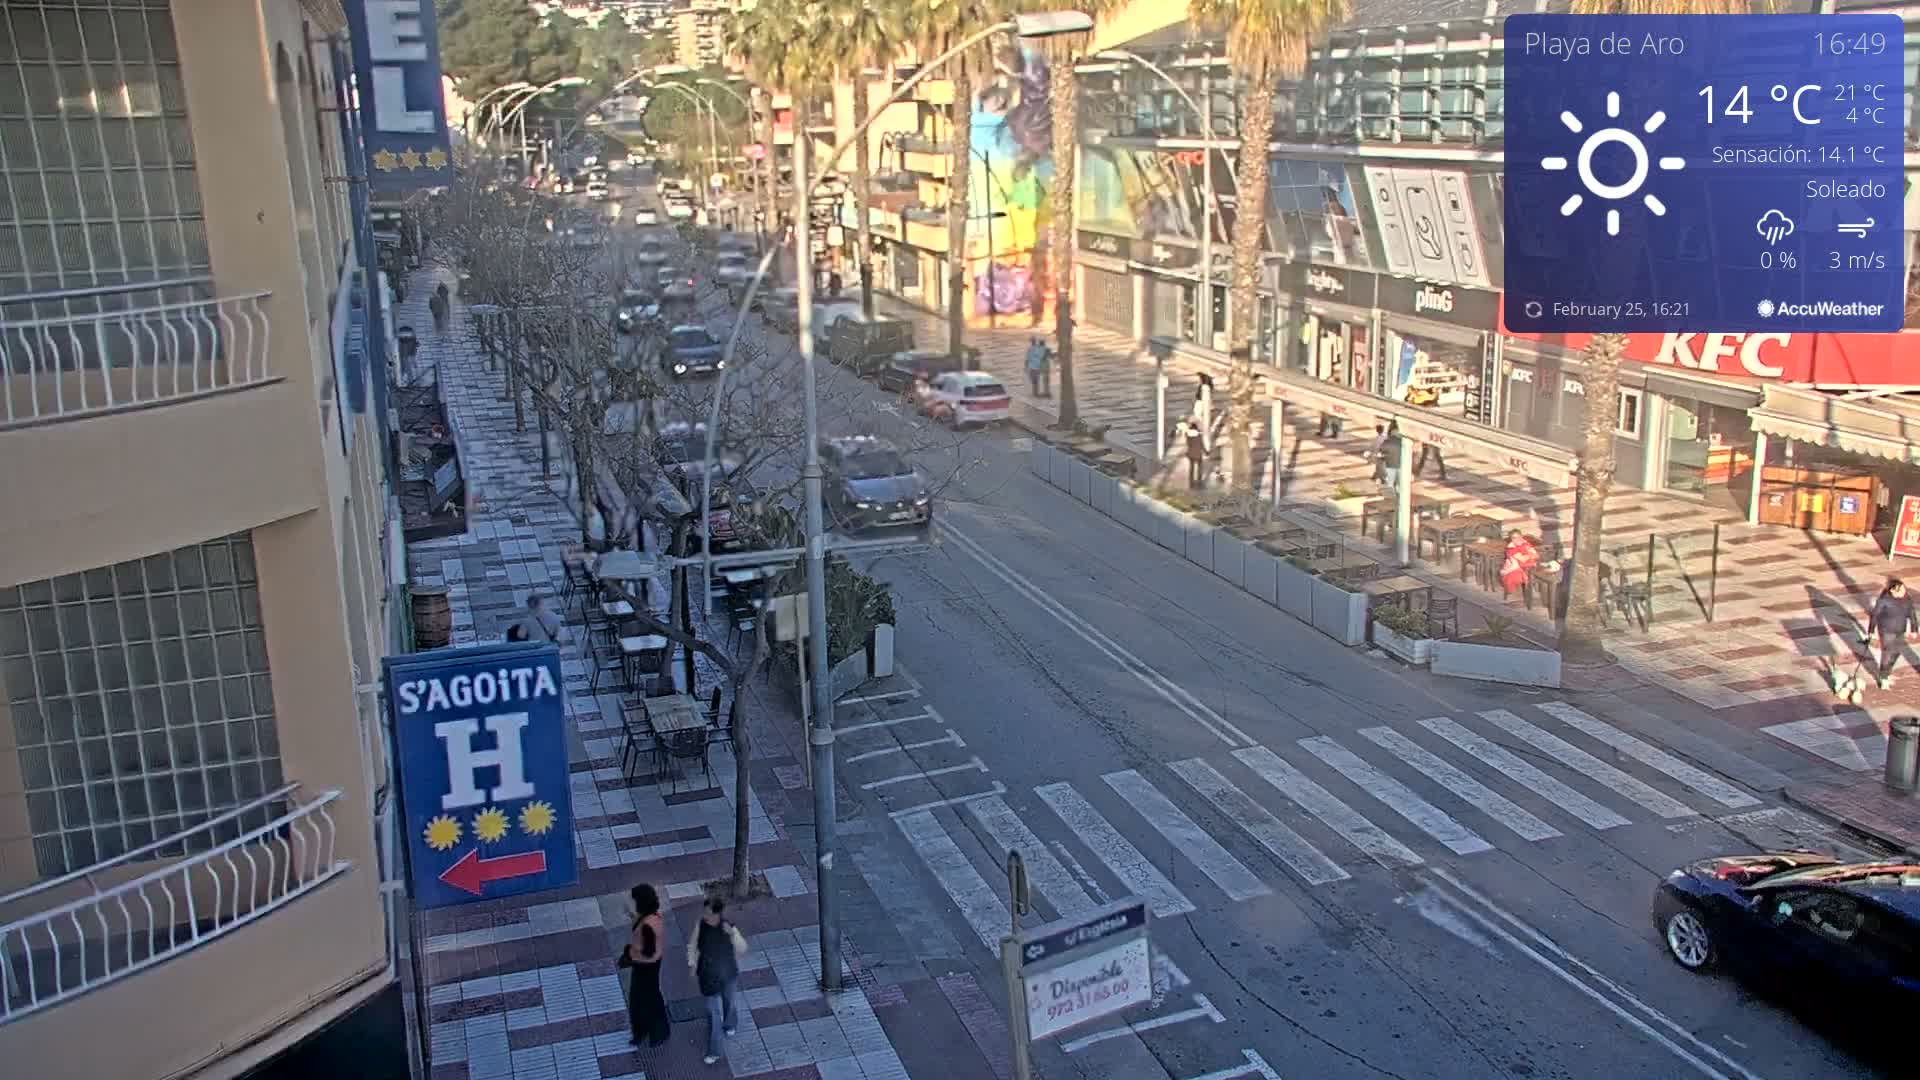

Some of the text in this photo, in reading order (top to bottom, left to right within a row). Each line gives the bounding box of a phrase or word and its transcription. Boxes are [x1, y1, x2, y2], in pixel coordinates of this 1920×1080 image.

[1511, 368, 1533, 383] KFC
[1654, 332, 1791, 377] KFC
[434, 712, 536, 810] H
